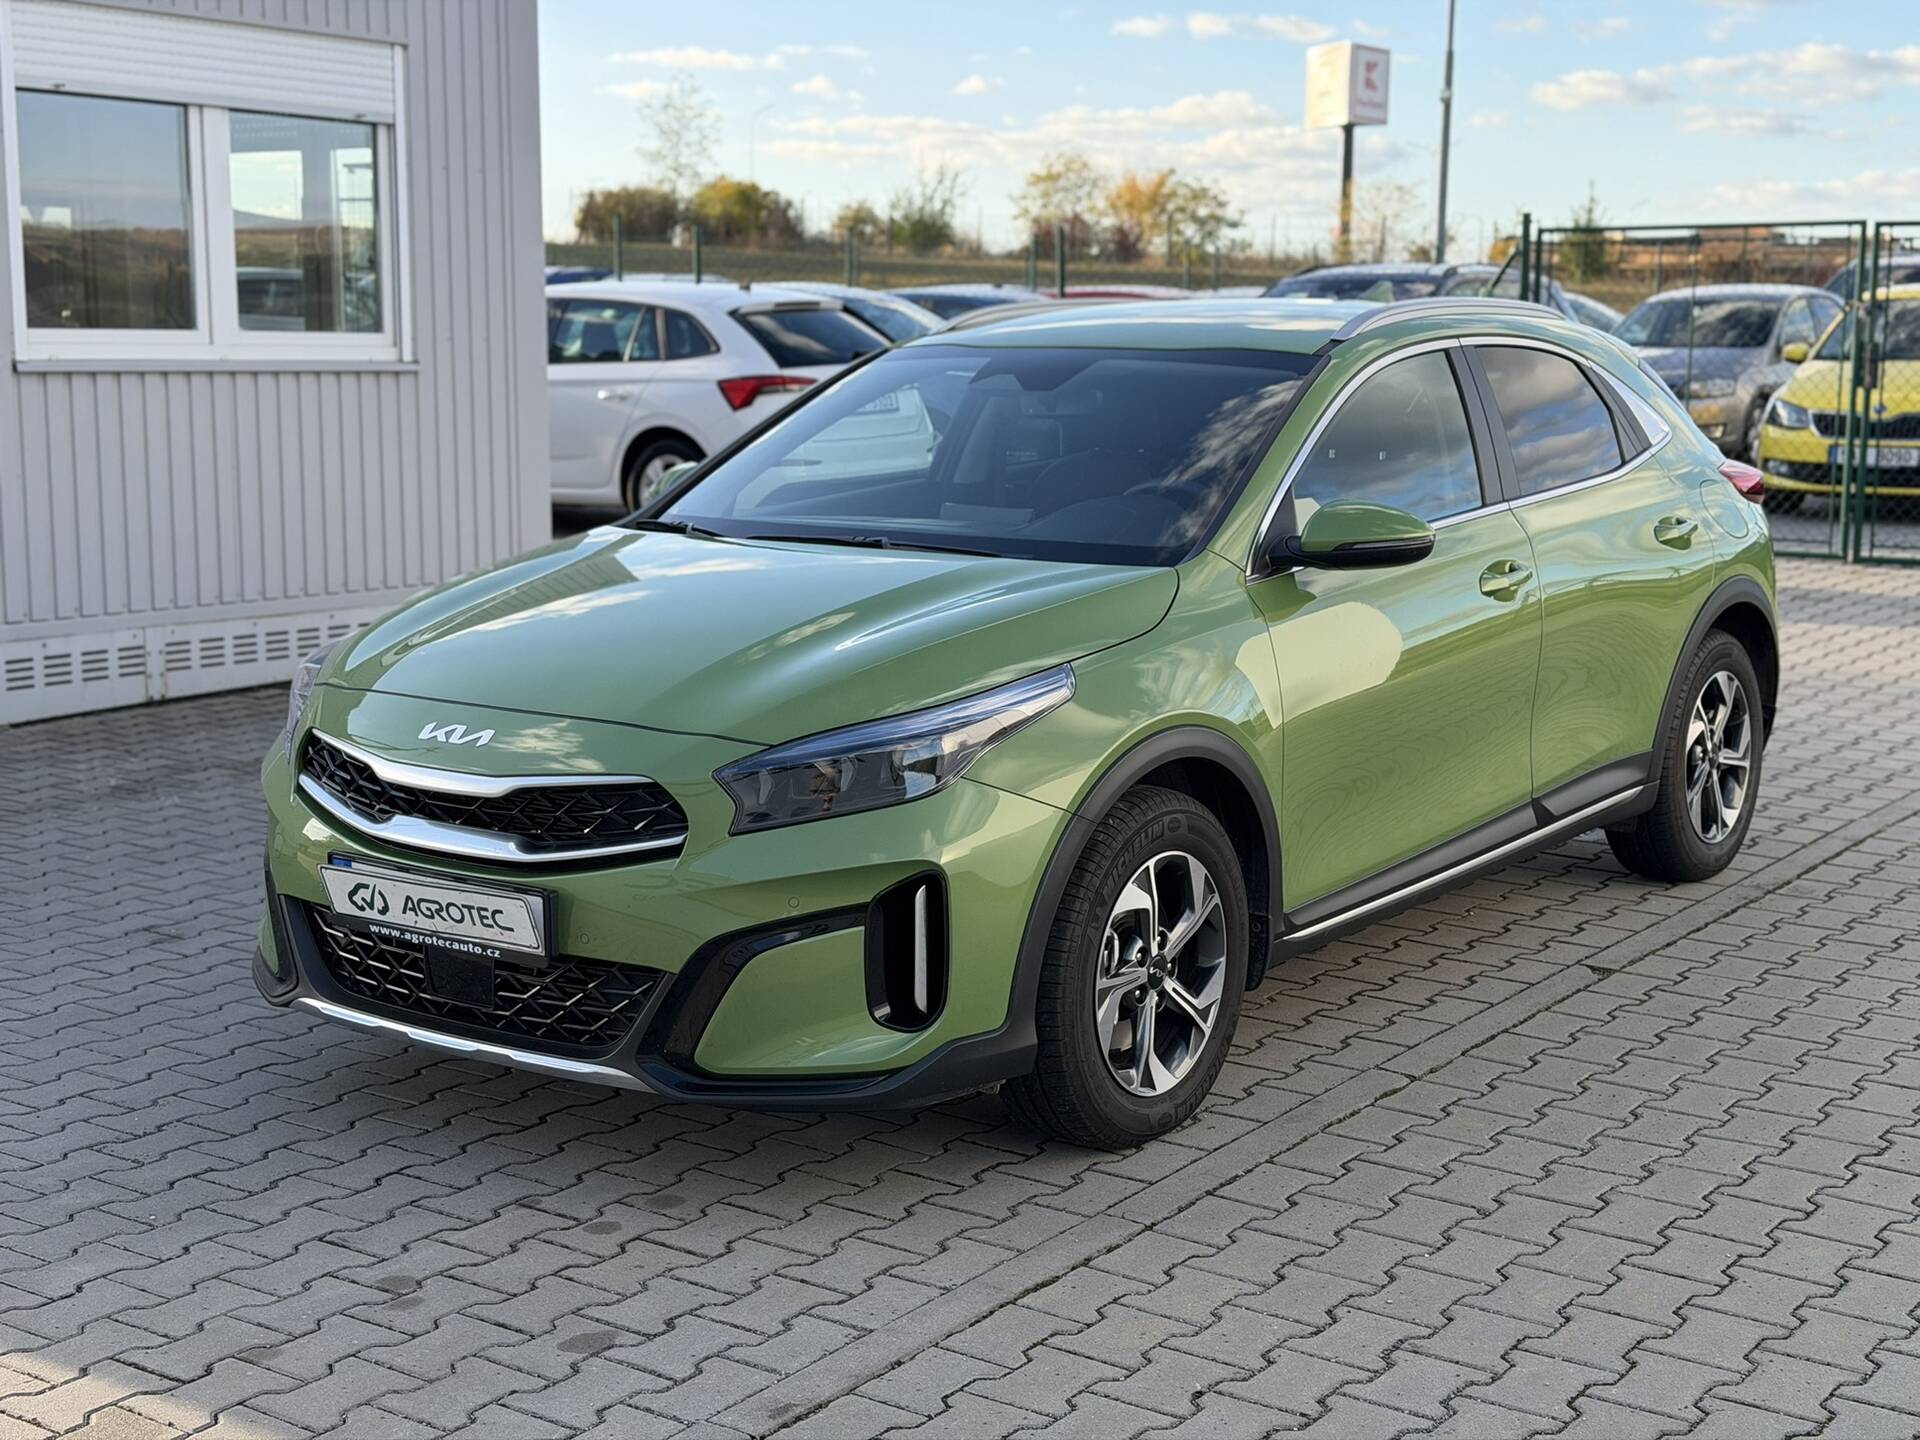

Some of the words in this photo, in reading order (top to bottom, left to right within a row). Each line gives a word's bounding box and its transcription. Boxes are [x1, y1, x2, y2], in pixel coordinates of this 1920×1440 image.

[418, 721, 495, 747] KIA
[402, 895, 514, 932] AGROTEC
[369, 924, 501, 958] www.agrotecauto.cz
